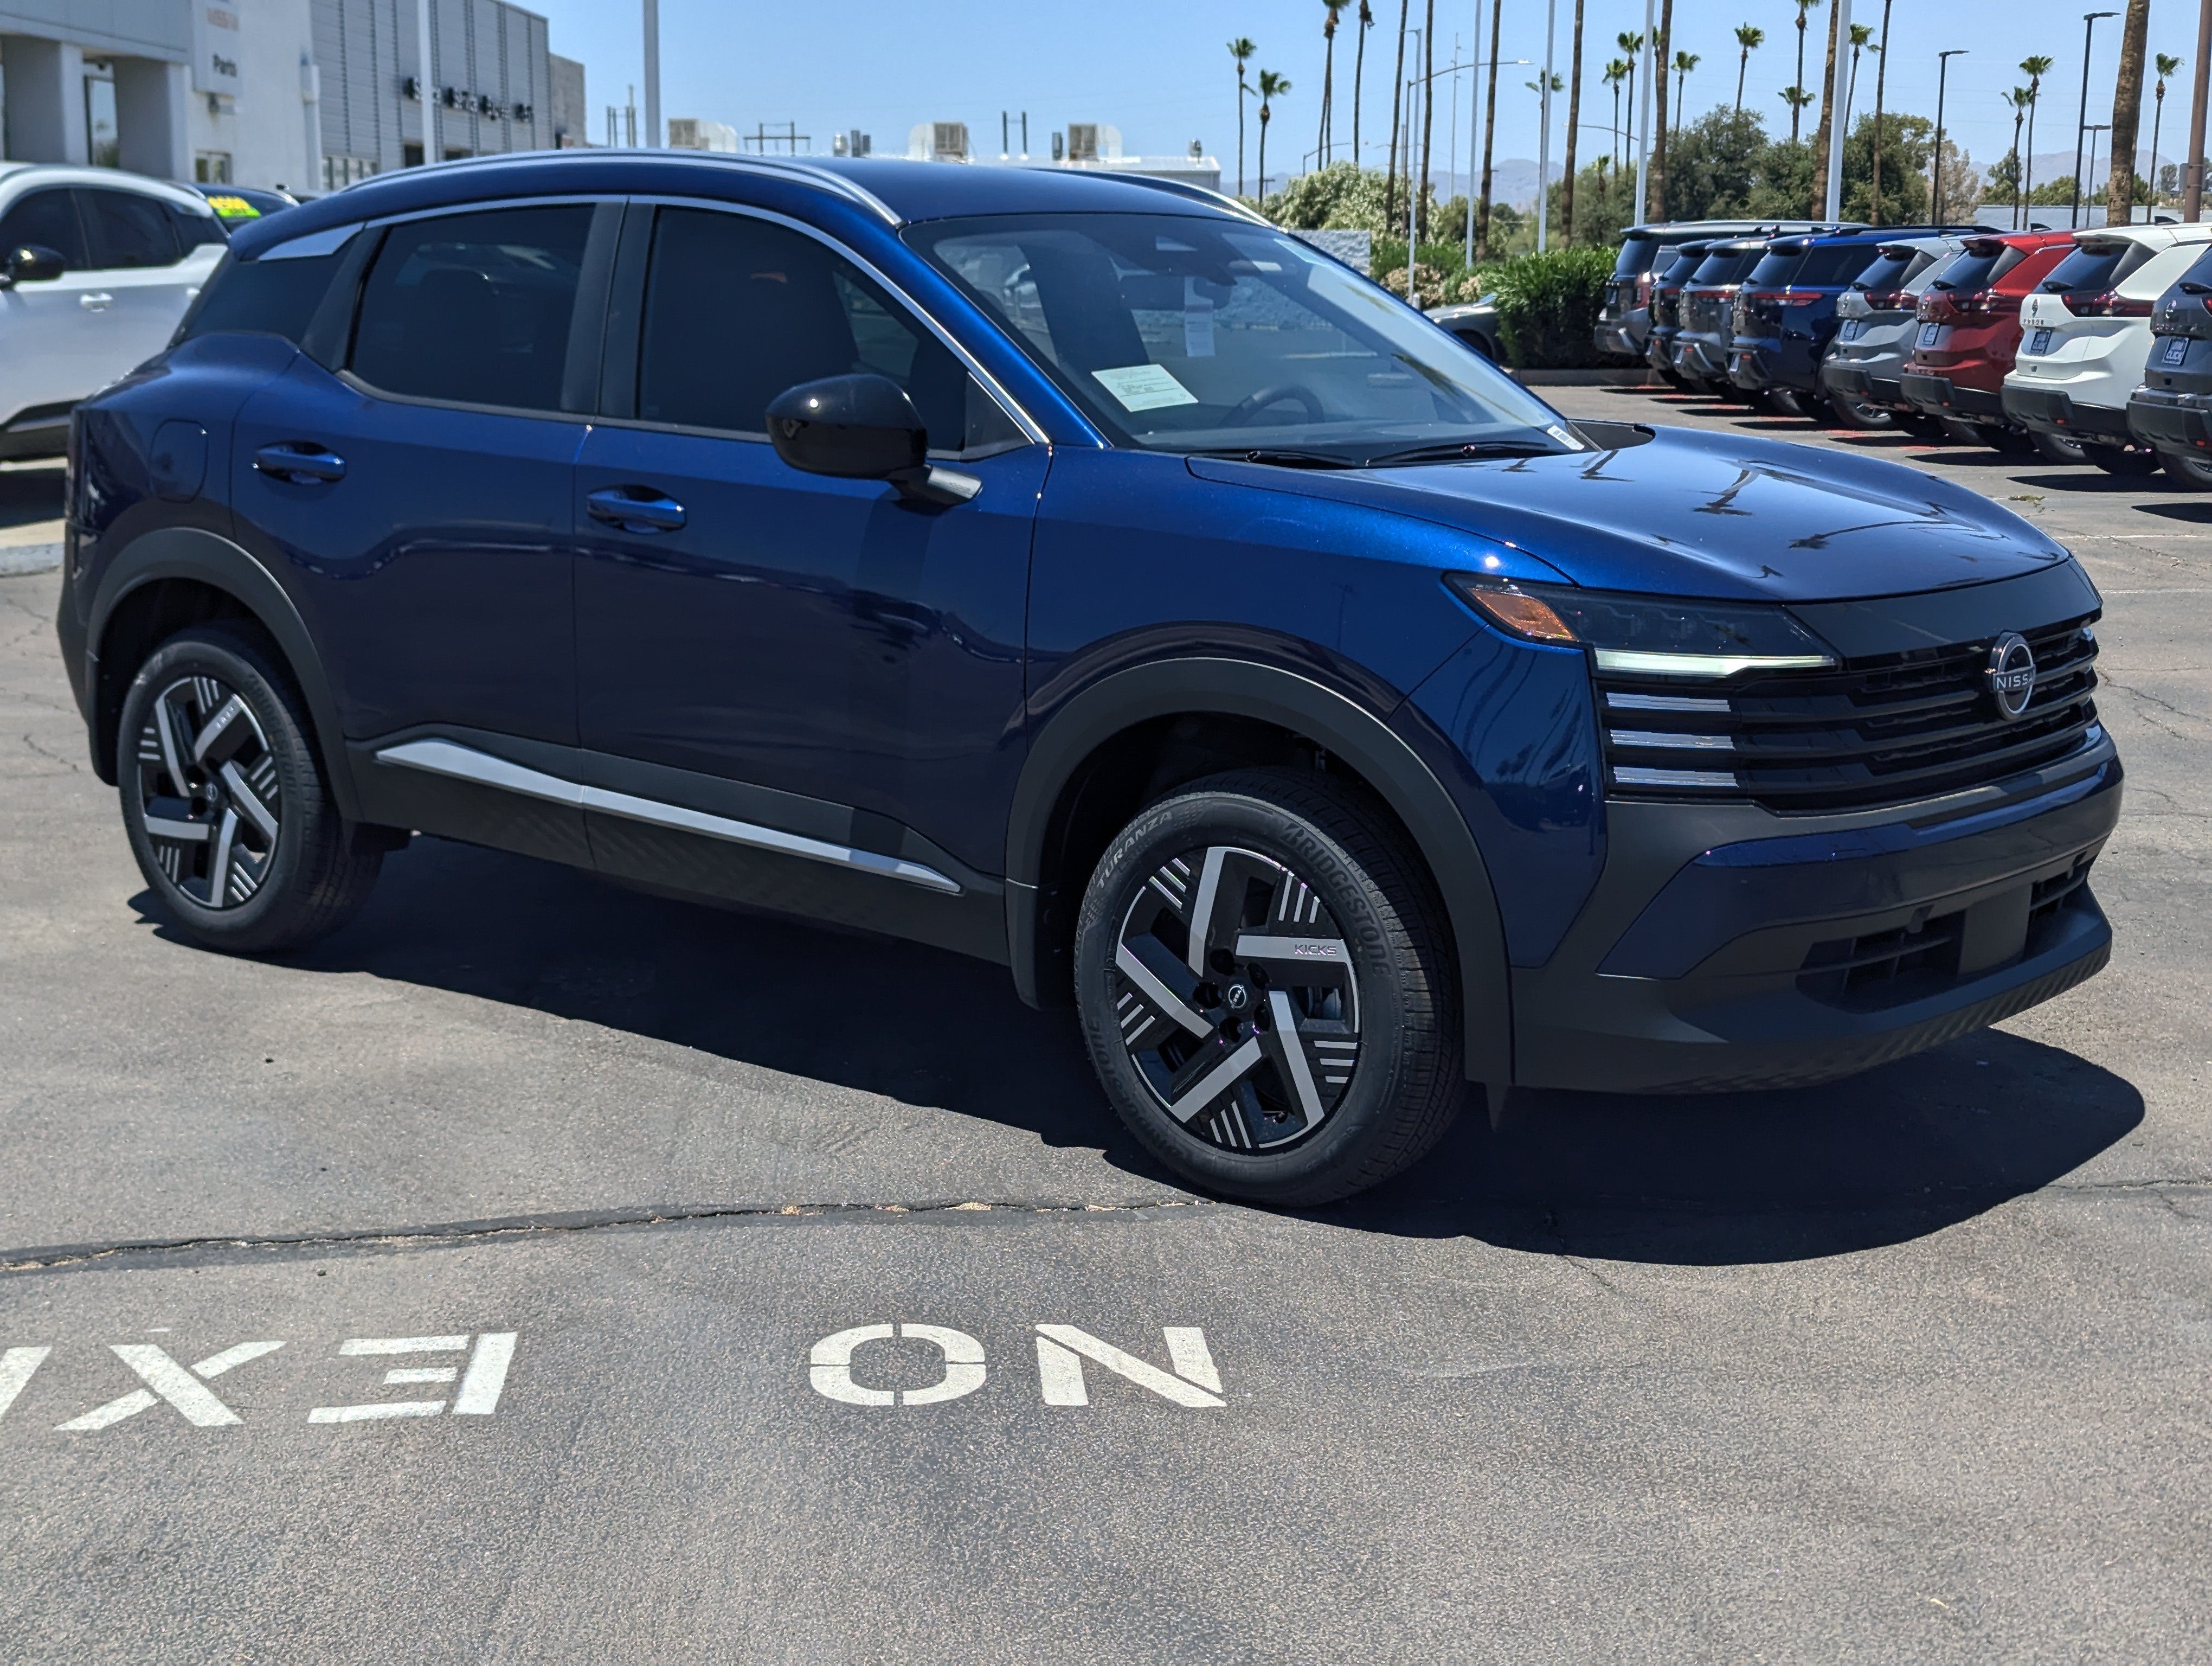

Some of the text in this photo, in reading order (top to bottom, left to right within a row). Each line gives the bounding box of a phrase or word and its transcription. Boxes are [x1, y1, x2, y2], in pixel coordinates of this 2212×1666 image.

[1996, 672, 2033, 689] NISS
[1097, 811, 1173, 888] TURANZA
[1280, 823, 1392, 977] BRIDGESTONE
[1295, 944, 1337, 956] KICKS
[809, 1323, 1227, 1407] NO
